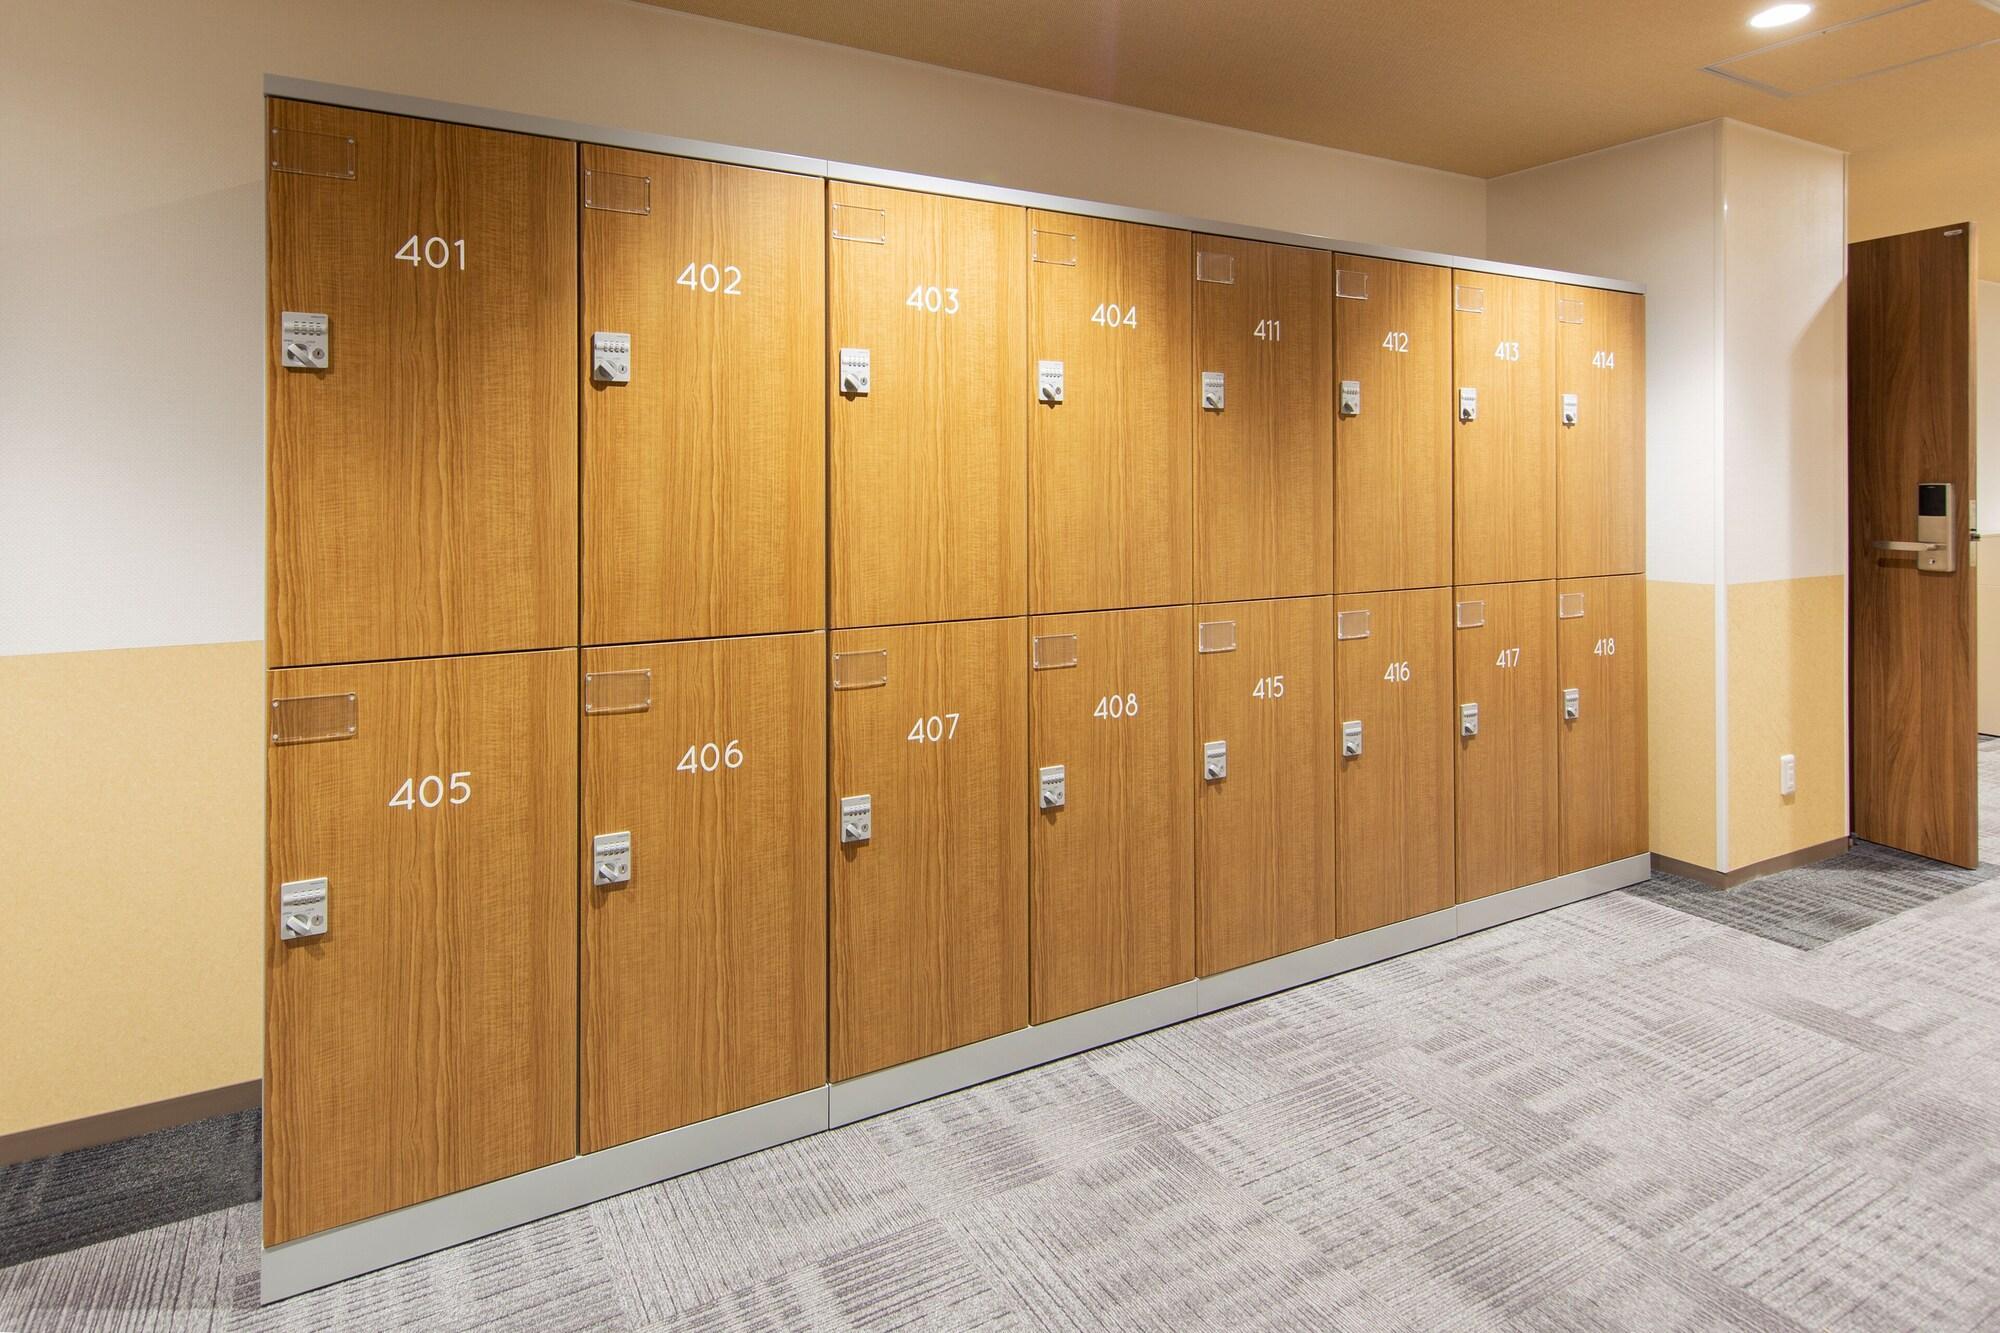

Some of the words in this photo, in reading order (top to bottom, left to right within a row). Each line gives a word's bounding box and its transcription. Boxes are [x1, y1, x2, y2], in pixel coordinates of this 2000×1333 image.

[394, 234, 465, 271] 401
[676, 262, 742, 296] 402
[905, 284, 960, 315] 403
[1090, 303, 1137, 329] 404
[1253, 319, 1280, 342] 411
[1382, 331, 1409, 353] 412
[1494, 341, 1521, 362] 413
[1591, 350, 1615, 369] 414
[1495, 647, 1521, 669] 417
[1593, 637, 1616, 657] 418
[1383, 661, 1411, 683] 416
[1252, 675, 1284, 700] 415
[1093, 692, 1139, 720] 408
[907, 712, 960, 744] 407
[676, 739, 744, 774] 406
[388, 771, 471, 810] 405
